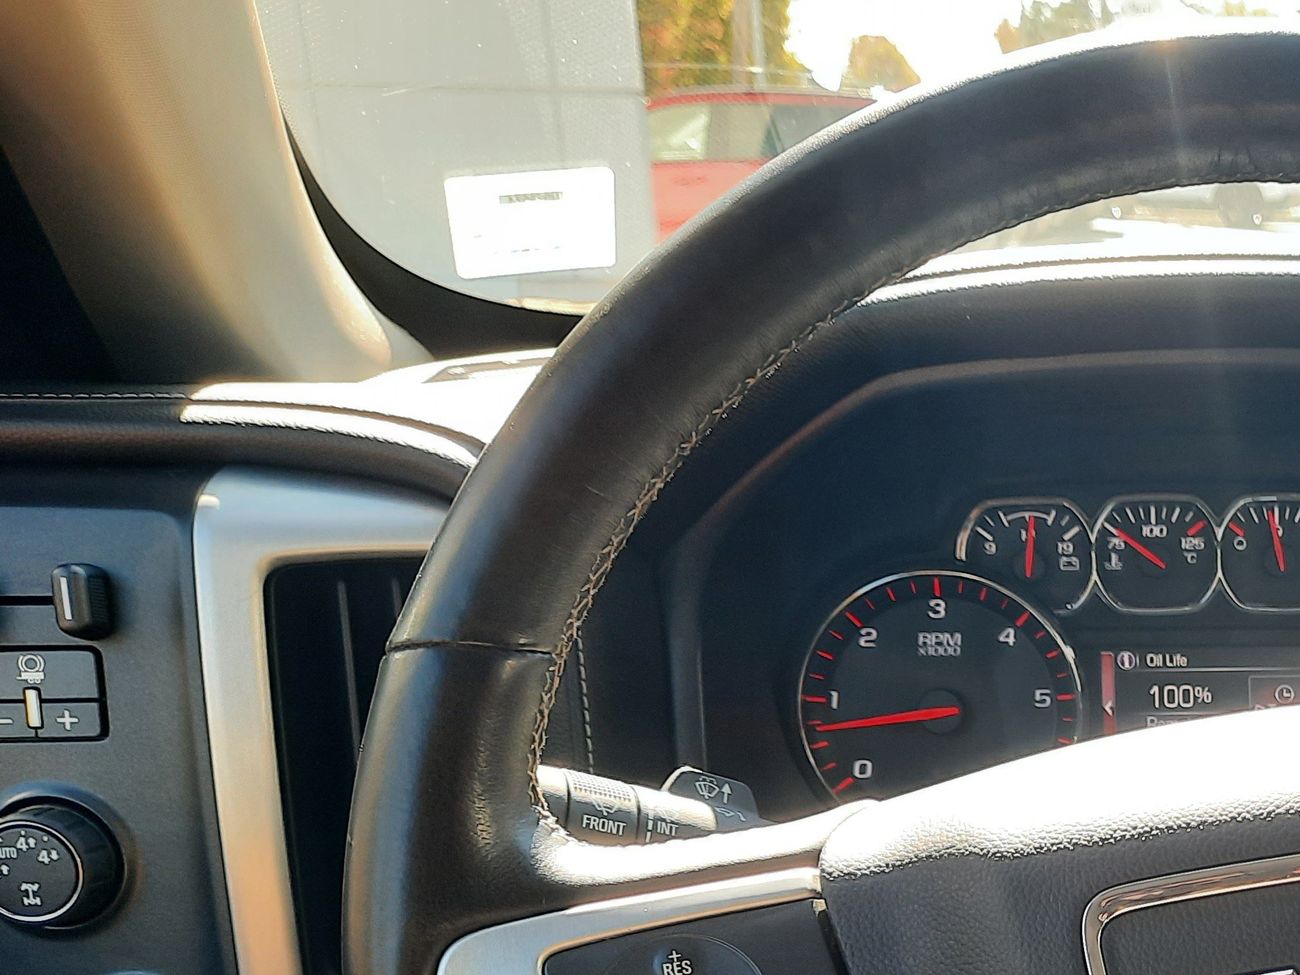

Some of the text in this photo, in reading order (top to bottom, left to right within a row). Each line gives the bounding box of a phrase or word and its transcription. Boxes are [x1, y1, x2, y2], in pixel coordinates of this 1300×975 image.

[1142, 524, 1167, 538] 100
[984, 541, 997, 555] 9
[1057, 541, 1074, 555] 19
[1181, 537, 1205, 550] 125
[928, 598, 947, 620] 3
[859, 628, 878, 648] 2
[918, 631, 962, 647] RPM
[998, 628, 1016, 647] 4
[1146, 653, 1188, 668] Oil Life
[828, 690, 840, 710] 1
[1034, 689, 1051, 708] 5
[1149, 684, 1212, 709] 100%
[852, 759, 873, 779] 0
[581, 813, 628, 837] FRONT
[656, 820, 680, 837] INT
